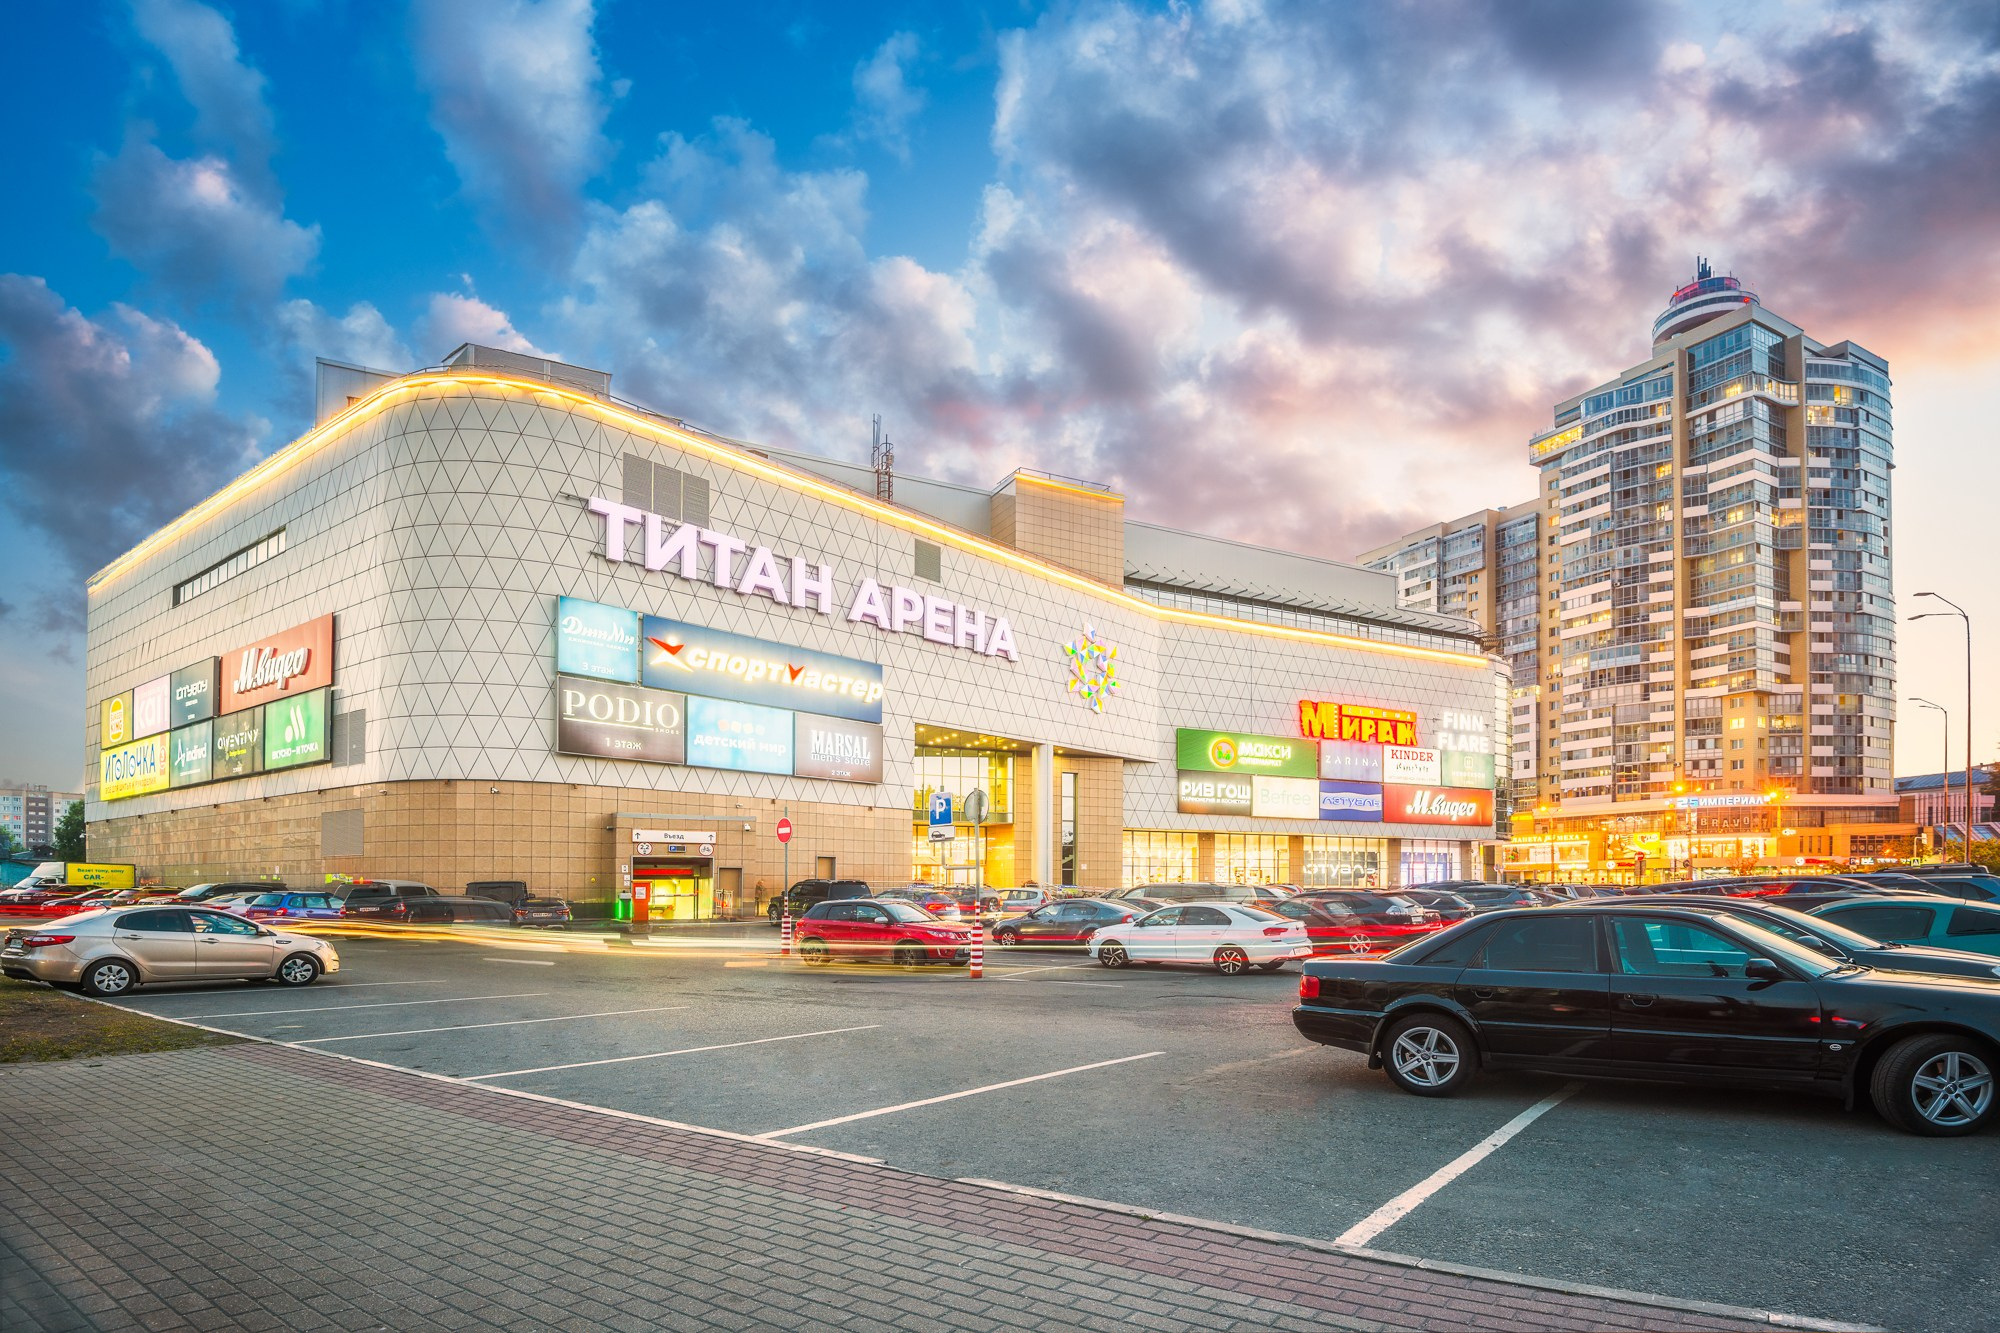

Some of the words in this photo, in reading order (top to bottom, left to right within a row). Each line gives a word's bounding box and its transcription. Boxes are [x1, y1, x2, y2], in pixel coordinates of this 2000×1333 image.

[588, 496, 832, 615] ТИТАН
[847, 577, 1019, 662] АРЕНА
[233, 647, 308, 691] М.видео
[582, 662, 588, 671] 3
[591, 664, 615, 675] этаж
[563, 689, 680, 728] PODIO
[1299, 700, 1418, 746] МИРАЖ
[1443, 712, 1484, 732] FINN
[605, 737, 610, 747] 1
[615, 740, 642, 750] этаж
[694, 733, 757, 752] детский
[758, 742, 786, 756] мир
[811, 729, 871, 759] MARSAL
[1437, 732, 1489, 753] FLARE
[1325, 755, 1379, 767] ZARINA
[1391, 749, 1434, 762] KINDER
[1181, 781, 1215, 797] РИВ
[1217, 783, 1250, 799] ГОШ
[1260, 789, 1311, 805] Befree
[1405, 789, 1477, 821] М.видео
[1699, 796, 1763, 806] ИМПЕРИАЛ
